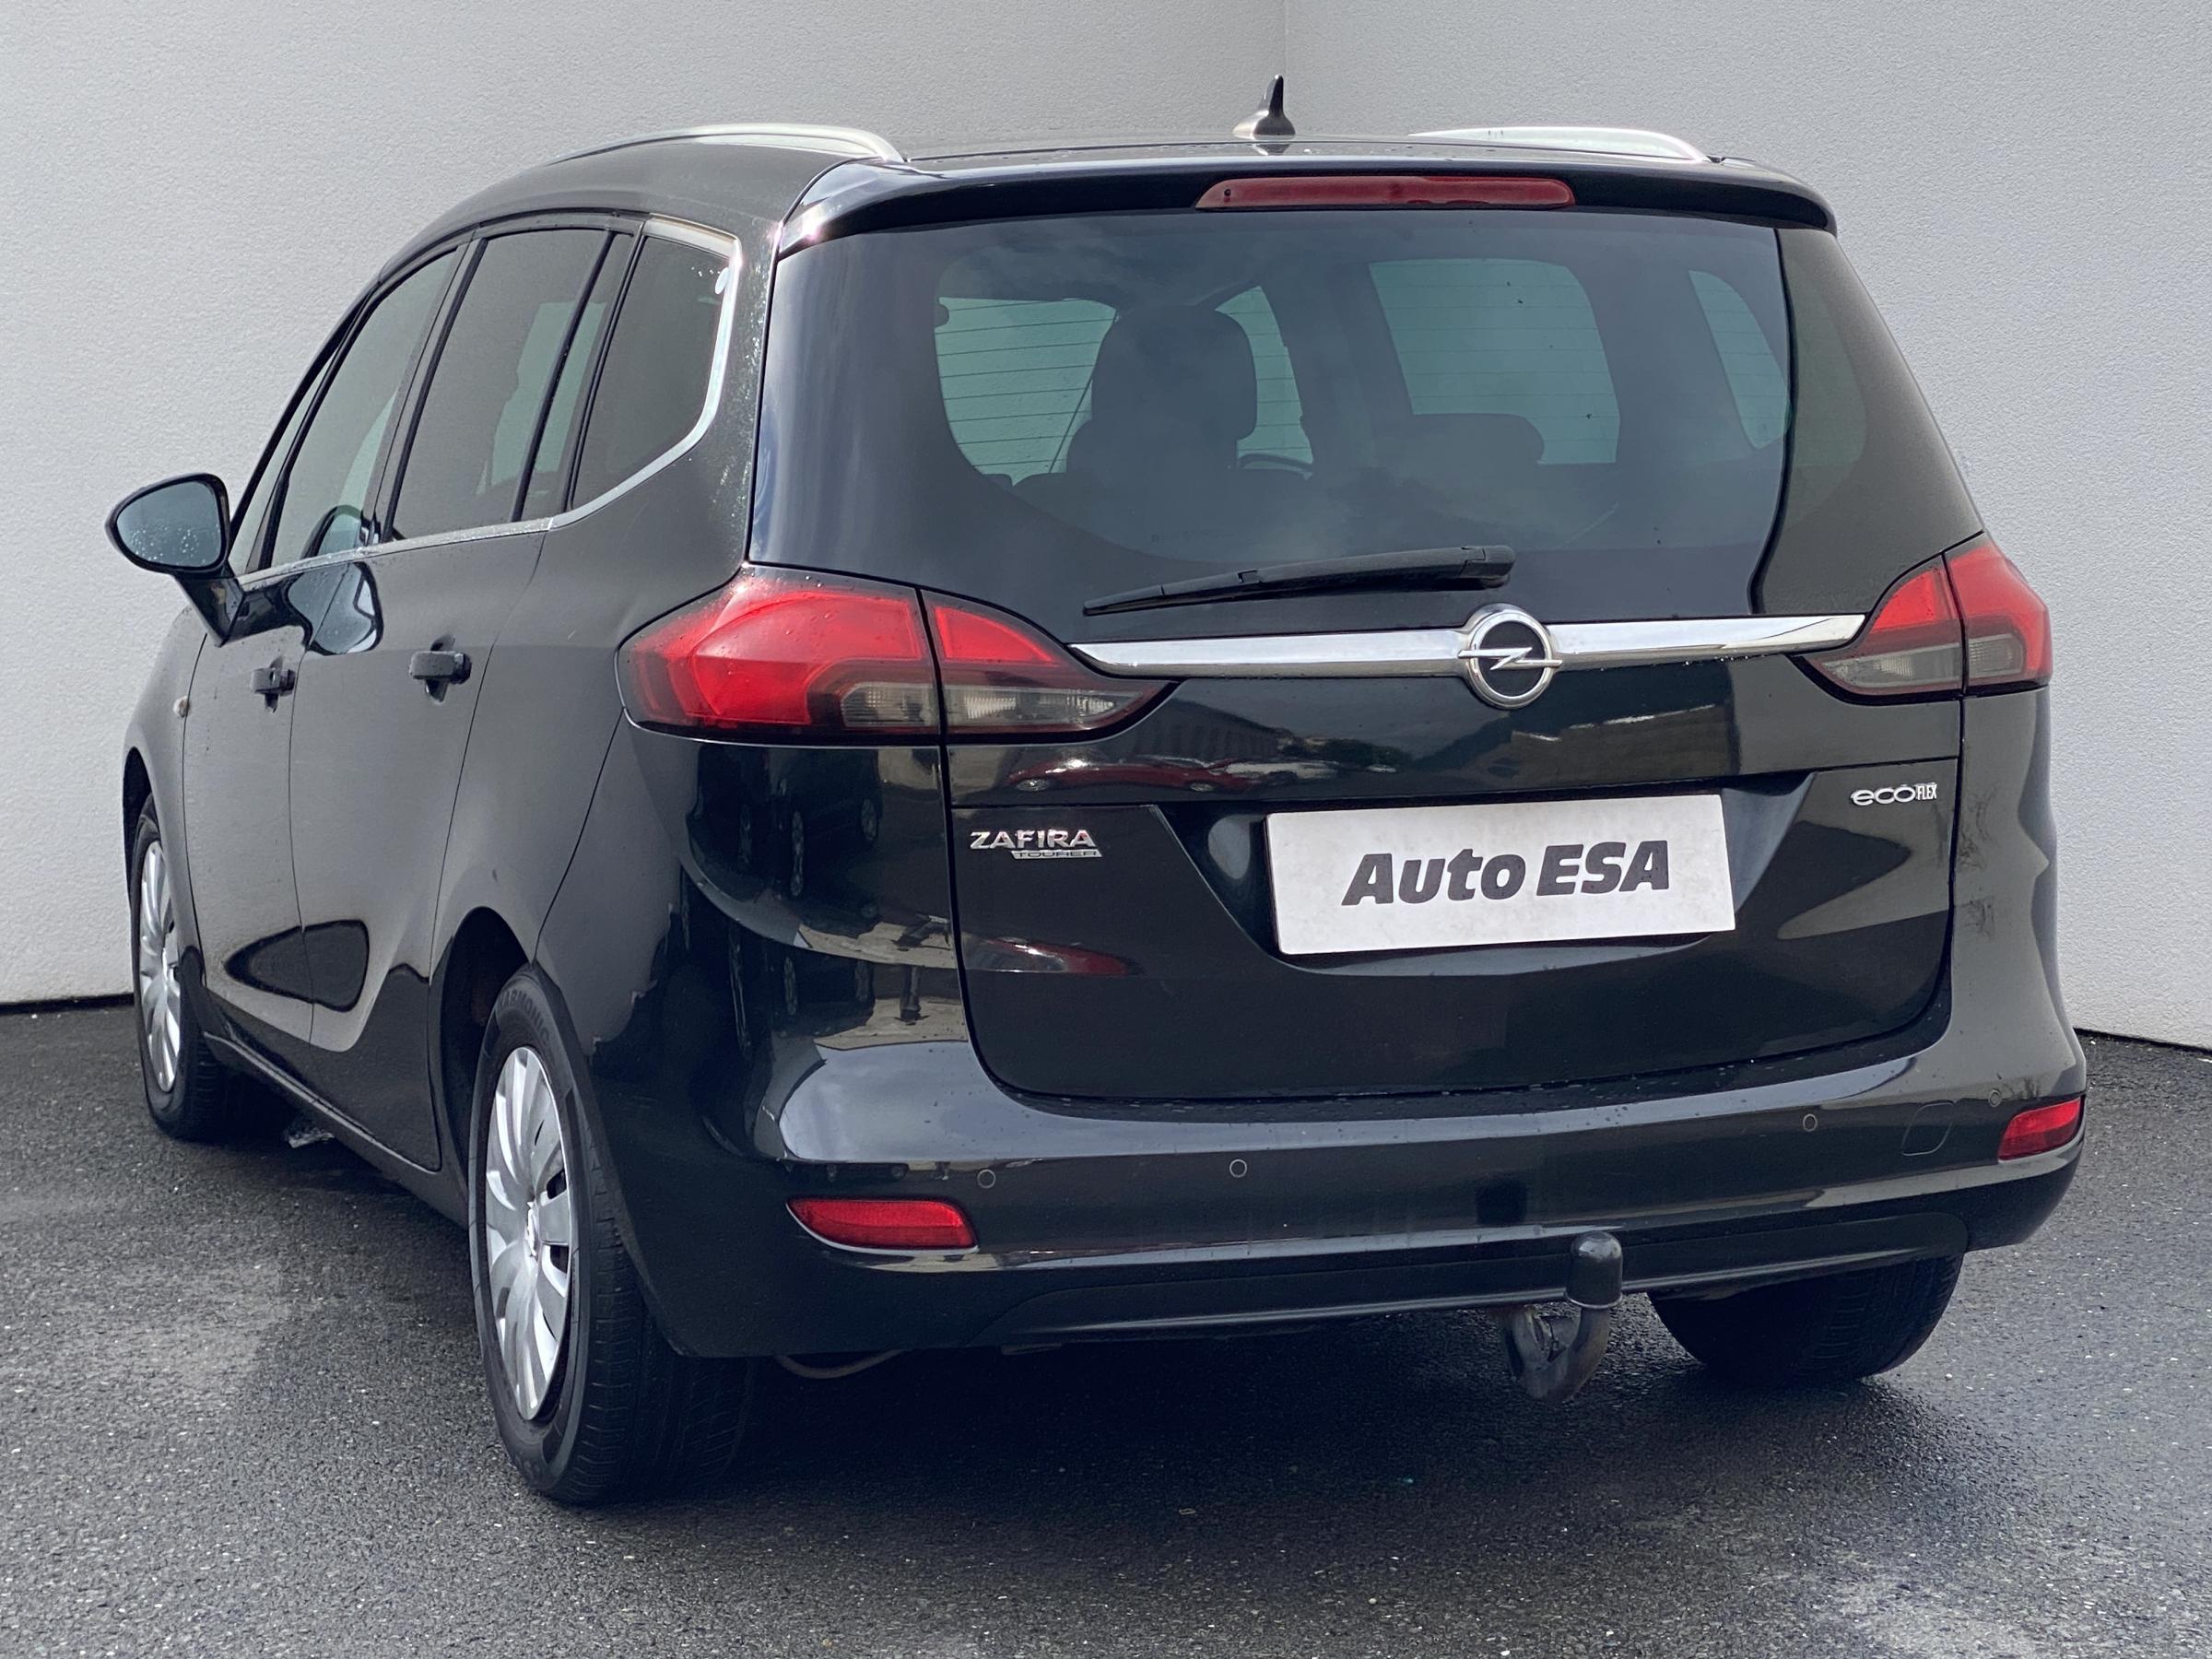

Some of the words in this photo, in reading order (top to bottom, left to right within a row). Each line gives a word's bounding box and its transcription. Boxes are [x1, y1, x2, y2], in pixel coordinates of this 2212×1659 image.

[970, 830, 1097, 850] ZAFIRA
[1017, 851, 1099, 859] TOURER
[1342, 849, 1525, 905] Auto
[1536, 841, 1668, 897] ESA
